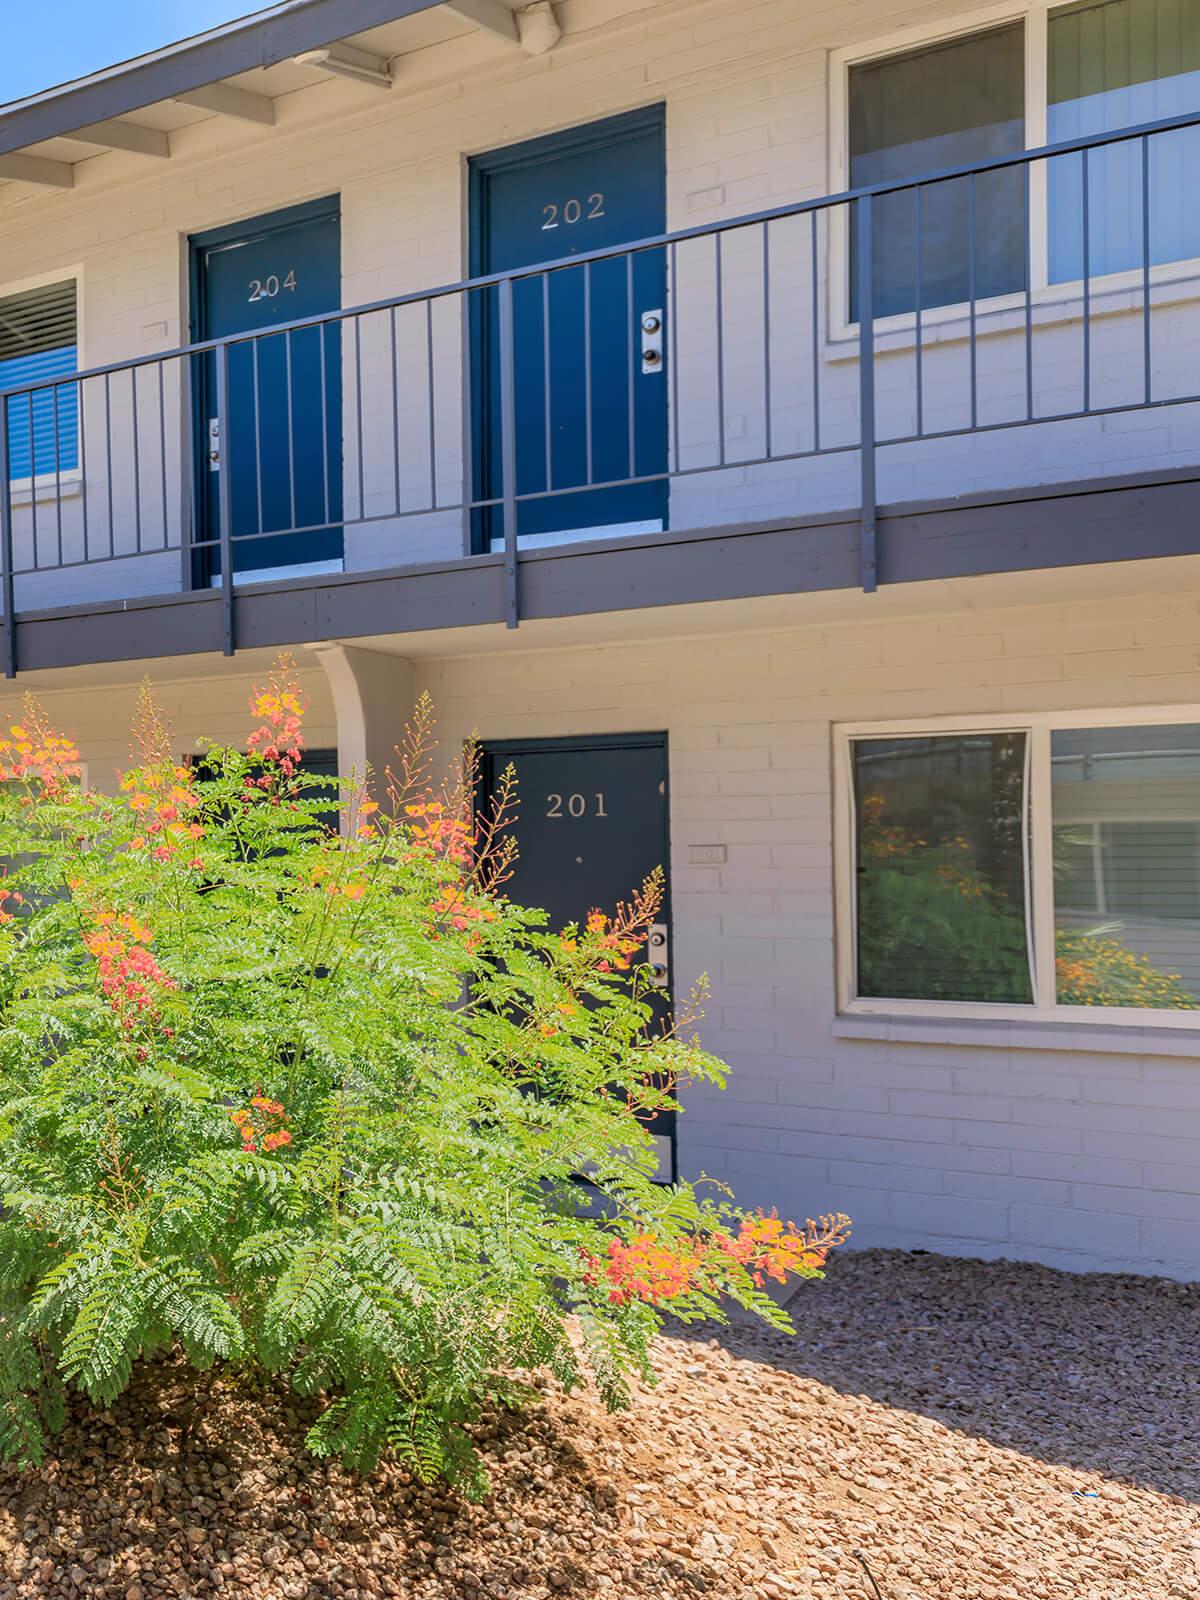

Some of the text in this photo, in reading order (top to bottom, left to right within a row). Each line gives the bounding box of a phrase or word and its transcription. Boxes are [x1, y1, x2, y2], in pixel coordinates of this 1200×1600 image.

[541, 193, 605, 230] 202
[247, 270, 297, 302] 204
[546, 793, 608, 817] 201
